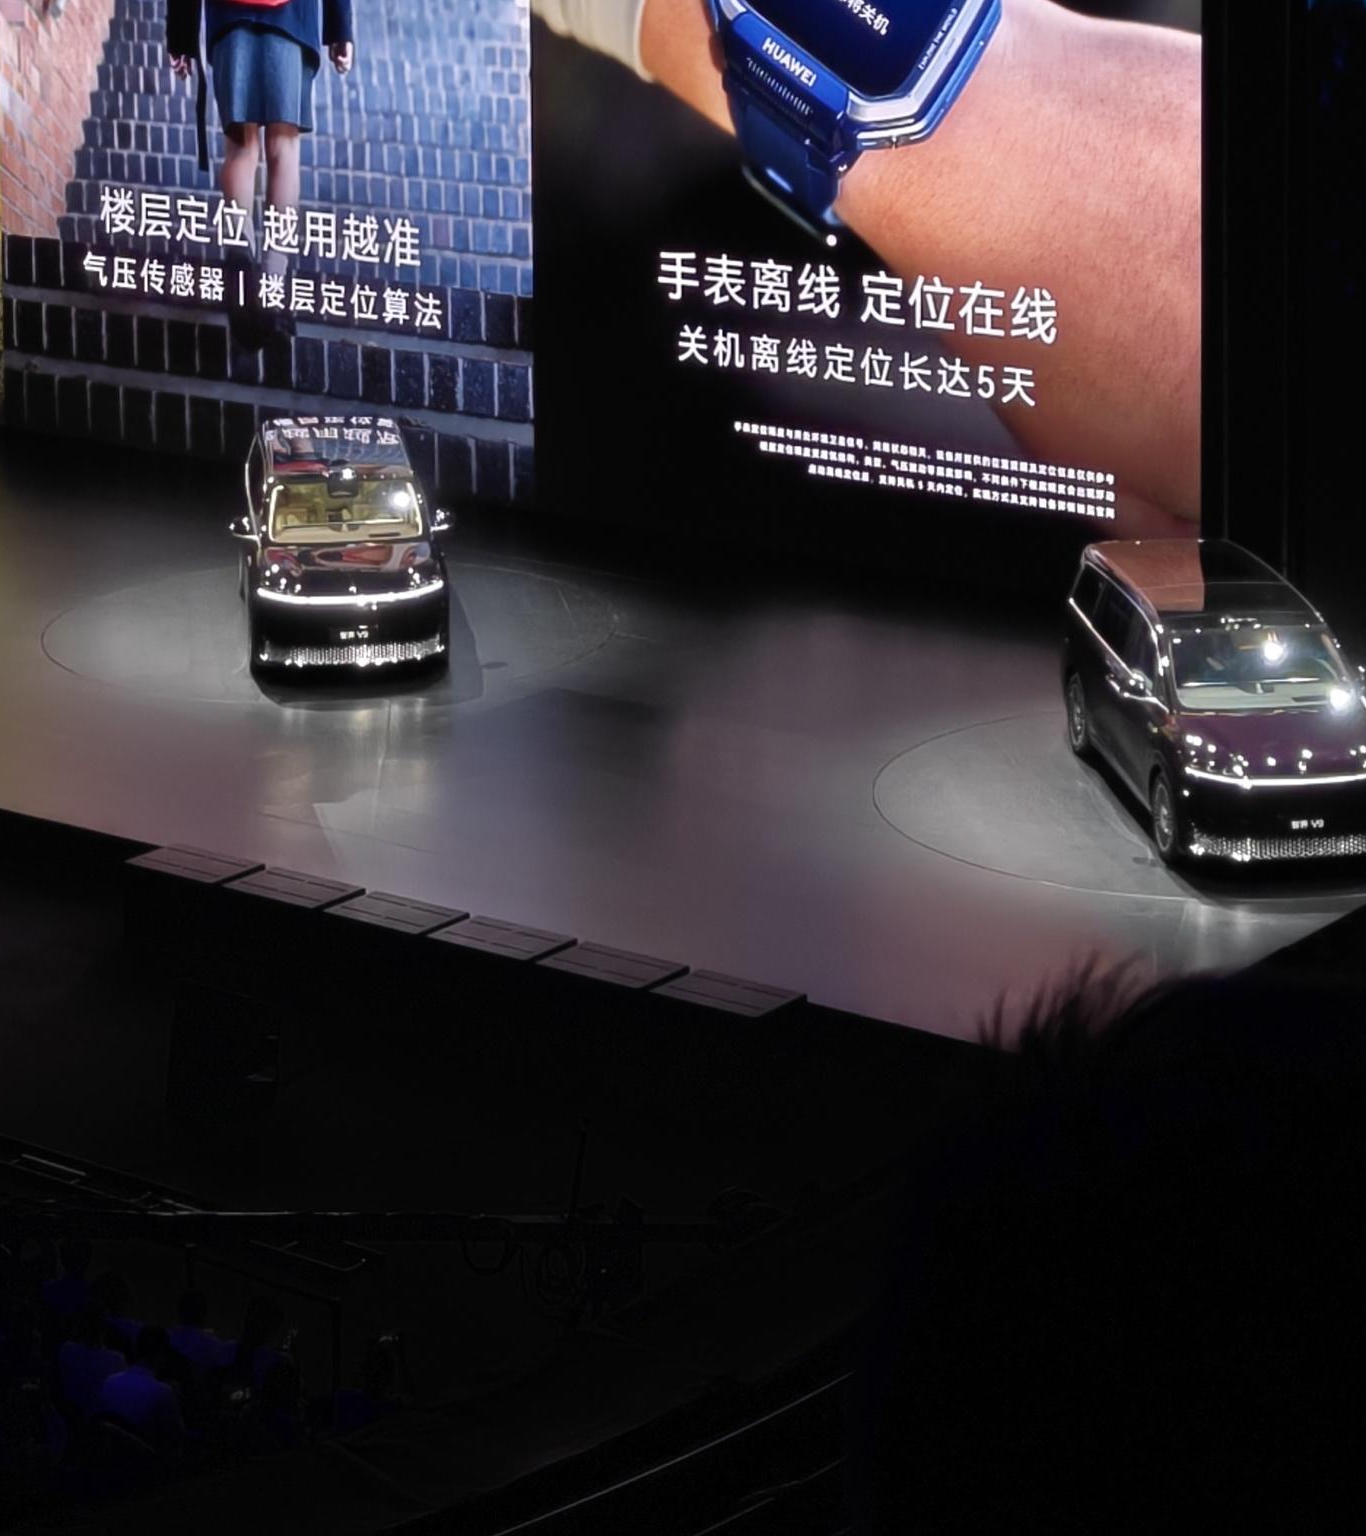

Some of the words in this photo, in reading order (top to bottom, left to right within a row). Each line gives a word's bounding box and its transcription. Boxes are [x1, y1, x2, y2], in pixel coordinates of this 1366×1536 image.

[762, 37, 817, 87] HUAWEI
[100, 186, 250, 247] 楼层定位
[262, 204, 422, 267] 越用越准
[82, 251, 226, 301] 气压传感器
[258, 273, 443, 330] 楼层定位算法
[656, 251, 841, 319] 手表离线
[860, 270, 1058, 345] 定位在线
[677, 324, 1036, 406] 关机离线定位长达5天
